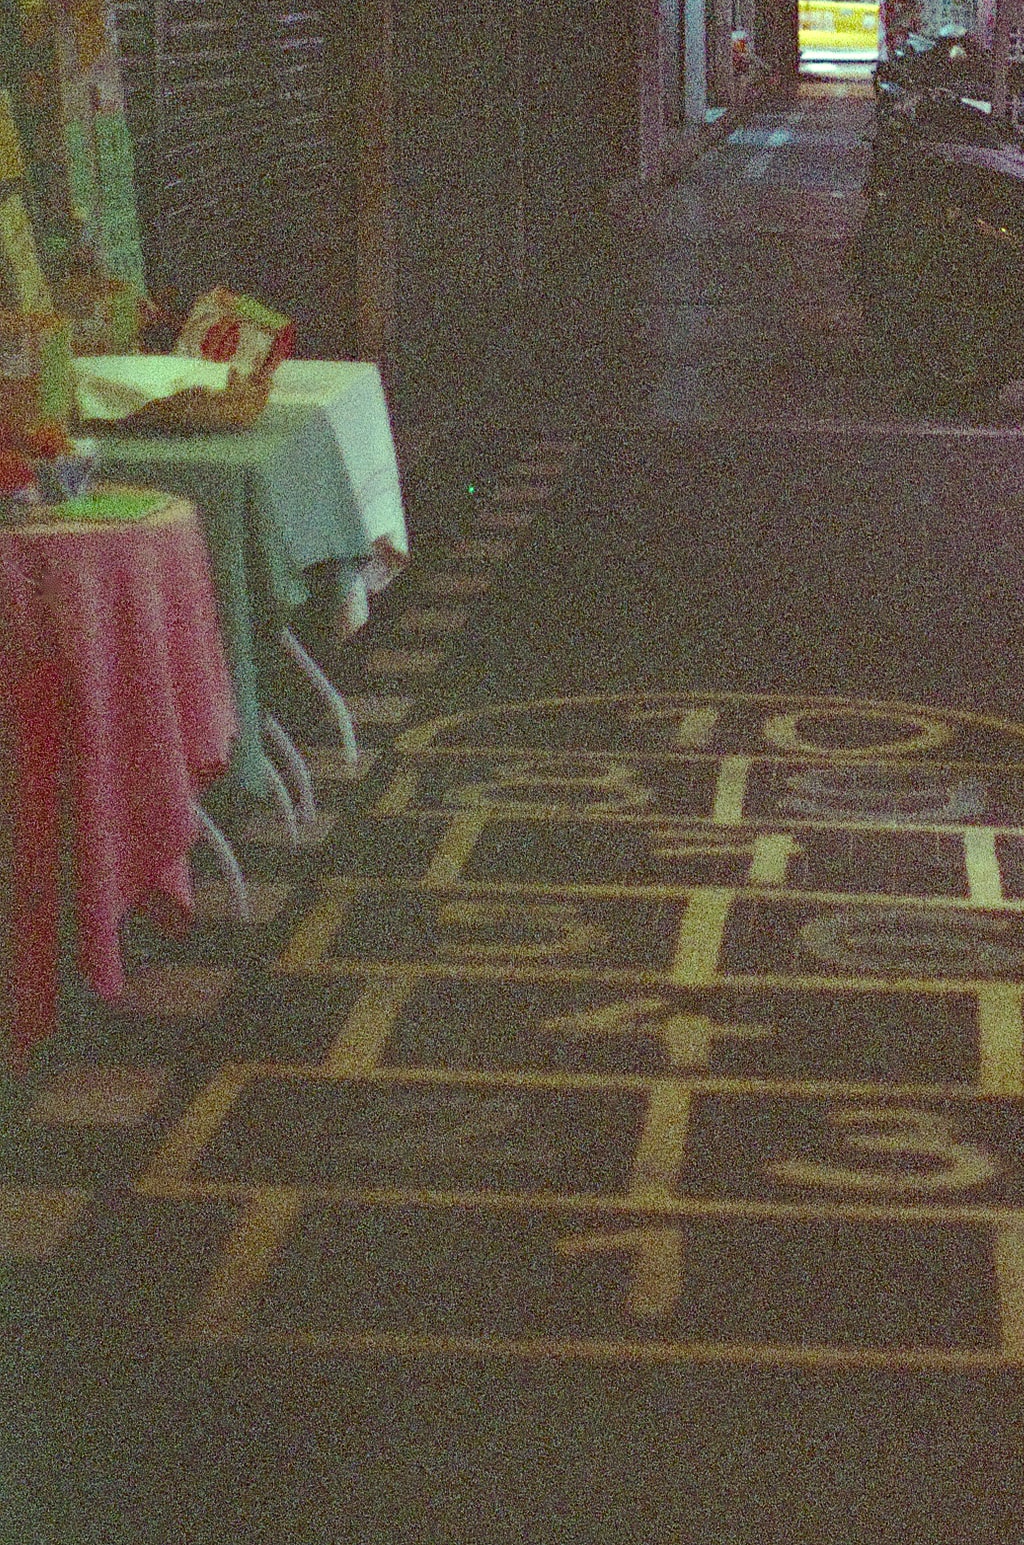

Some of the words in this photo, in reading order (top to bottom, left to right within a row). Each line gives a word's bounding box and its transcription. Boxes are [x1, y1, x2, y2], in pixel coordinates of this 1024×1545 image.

[630, 706, 957, 757] 10
[542, 996, 775, 1067] 4
[764, 1106, 999, 1194] 3
[555, 1226, 684, 1317] 1
